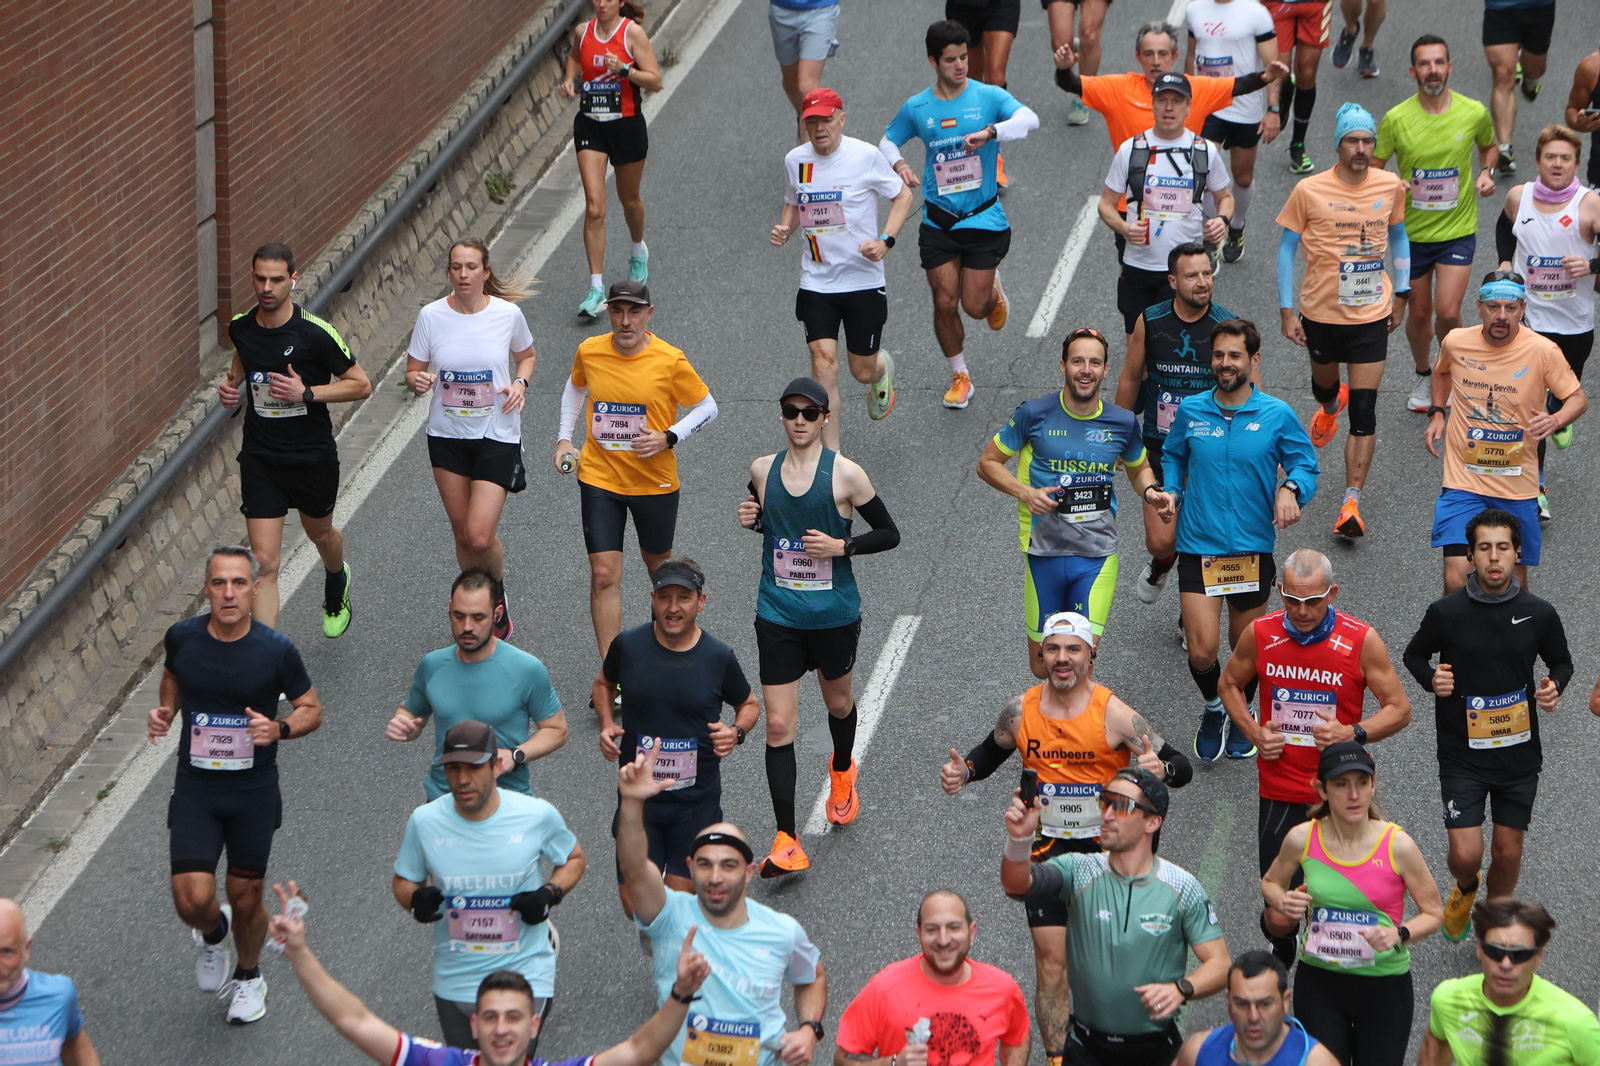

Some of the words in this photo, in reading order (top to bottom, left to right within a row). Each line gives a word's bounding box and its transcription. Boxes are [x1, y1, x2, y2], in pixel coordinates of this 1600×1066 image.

[593, 82, 616, 91] ZURICH
[592, 96, 608, 104] 3175
[1427, 169, 1455, 178] ZURICH
[946, 174, 974, 185] ALFREDITO
[1160, 178, 1189, 187] ZURICH
[811, 193, 838, 201] ZURICH
[1159, 192, 1177, 201] 7620
[812, 206, 829, 216] 7517
[1335, 221, 1361, 229] Maratón
[1356, 262, 1382, 271] ZURICH
[1542, 273, 1560, 281] 7921
[1355, 278, 1371, 286] 8441
[1530, 283, 1548, 291] CHICO
[457, 373, 487, 381] ZURICH
[1462, 378, 1489, 389] Maratón
[458, 387, 476, 396] 7756
[611, 404, 640, 413] ZURICH
[610, 420, 629, 428] 7894
[1486, 431, 1518, 440] ZURICH
[1484, 447, 1505, 456] 5770
[1048, 459, 1109, 473] TUSSAM
[1074, 474, 1107, 484] ZURICH
[1073, 490, 1094, 500] 3423
[1070, 502, 1097, 512] FRANCIS
[792, 557, 813, 567] 6960
[1220, 563, 1241, 572] 4555
[789, 571, 816, 579] PABLITO
[1217, 575, 1245, 583] R.MATEO
[1265, 663, 1343, 686] DANMARK
[1293, 692, 1330, 702] ZURICH
[1488, 693, 1521, 707] ZURICH
[1292, 709, 1314, 720] 7077
[211, 716, 248, 726] ZURICH
[1489, 714, 1511, 725] 5805
[1281, 723, 1301, 732] TEAM
[1490, 728, 1512, 736] OMAR
[210, 734, 233, 745] 7929
[1027, 739, 1096, 760] Runbeers
[655, 757, 675, 767] 7971
[652, 771, 680, 779] ANDREU
[1059, 786, 1096, 795] ZURICH
[1059, 804, 1082, 813] 9905
[1063, 819, 1080, 827] Luyx
[443, 874, 526, 891] VALENCIA
[1331, 911, 1370, 923] ZURICH
[470, 917, 495, 928] 7157
[1329, 931, 1352, 941] 6508
[1317, 946, 1363, 957] FREDERIQUE
[711, 1022, 754, 1036] ZURICH
